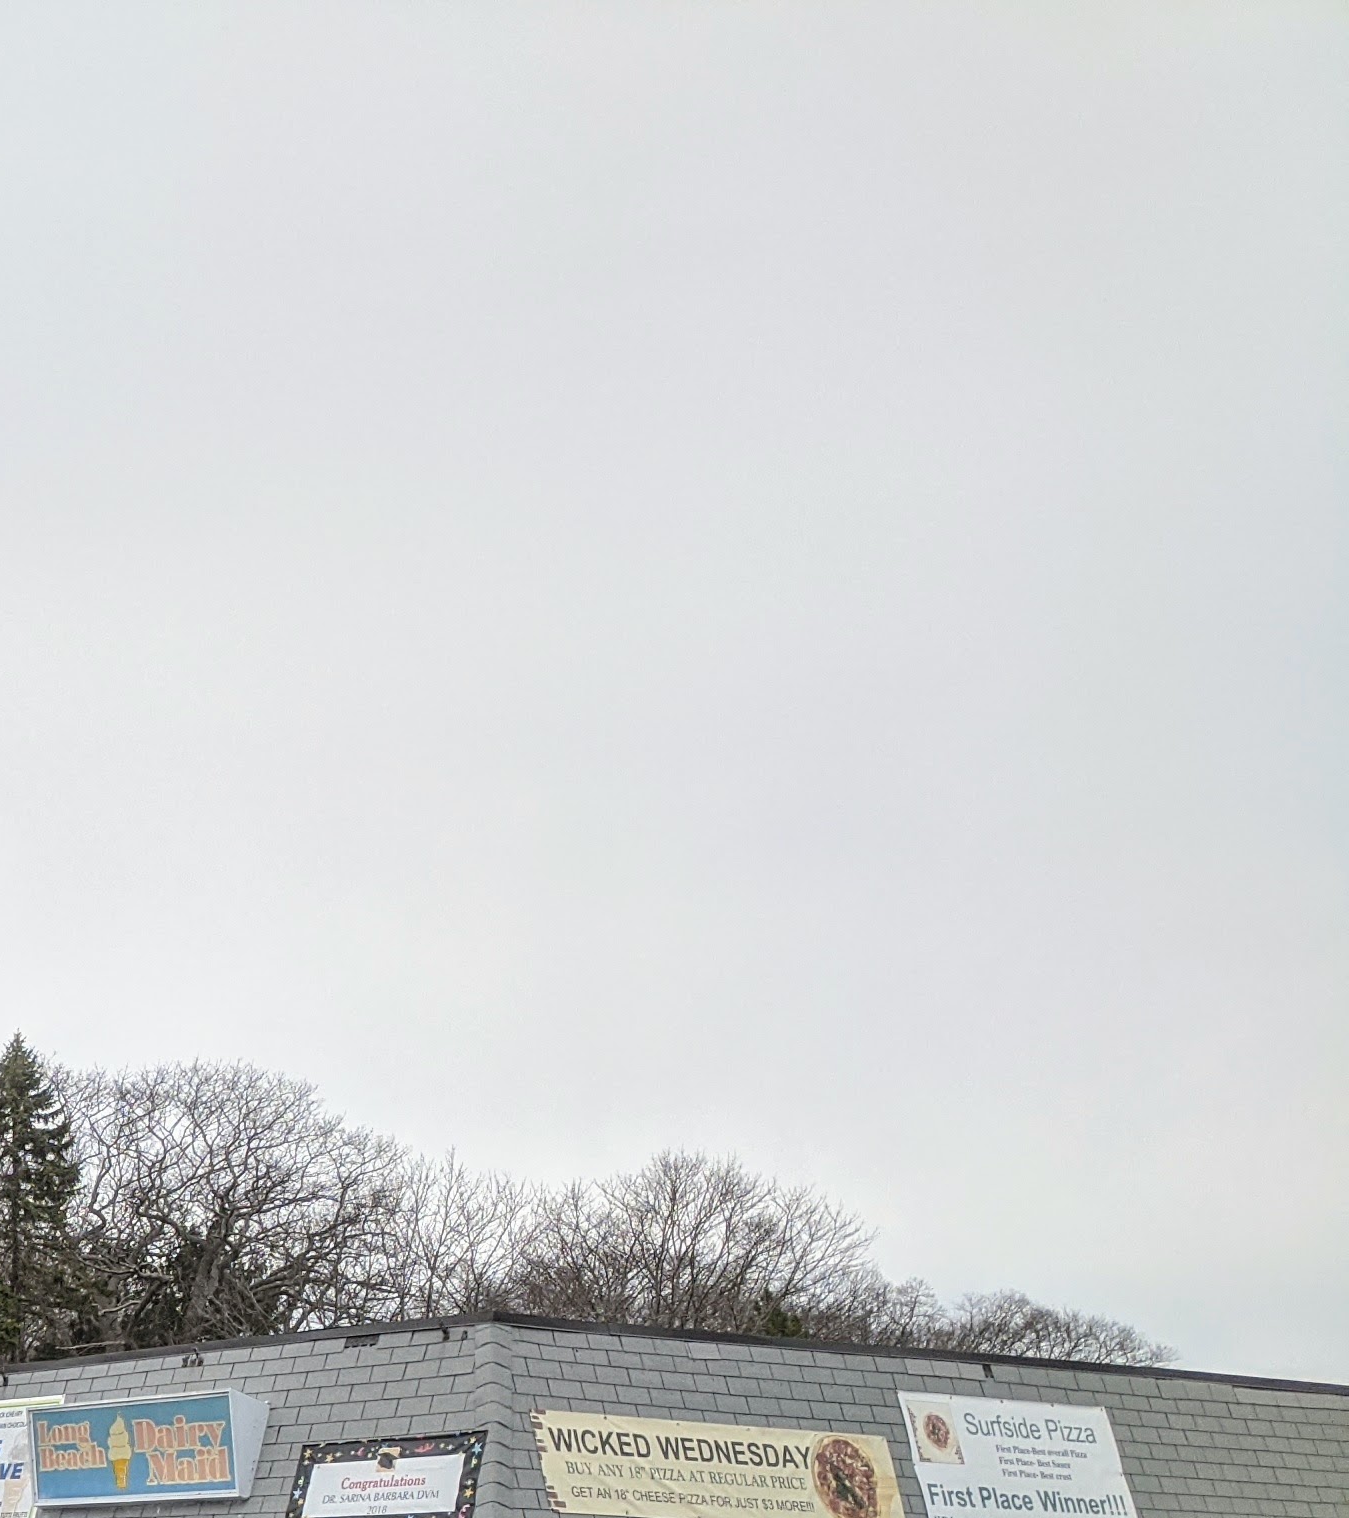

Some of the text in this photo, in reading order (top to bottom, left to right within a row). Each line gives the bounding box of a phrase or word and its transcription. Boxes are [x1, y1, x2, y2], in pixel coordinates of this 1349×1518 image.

[37, 1421, 91, 1448] Long
[132, 1415, 225, 1452] Dairy
[963, 1412, 1097, 1444] Surfside Pizza
[39, 1442, 107, 1471] Beach
[548, 1427, 810, 1470] WICKED WEDNESDAY
[146, 1446, 231, 1485] Maid
[565, 1461, 593, 1475] BUY
[598, 1464, 624, 1478] ANY
[650, 1467, 685, 1482] PIZZA
[689, 1470, 706, 1483] AT
[708, 1471, 769, 1488] REGULAR
[770, 1475, 808, 1490] PRICE
[341, 1474, 426, 1492] Congratulations
[373, 1491, 414, 1502] BARBARA
[417, 1490, 439, 1500] DVM
[367, 1505, 387, 1515] 2018
[571, 1486, 593, 1498] GET
[597, 1487, 611, 1499] AN
[632, 1489, 676, 1504] CHEESE
[678, 1493, 710, 1506] PIZZA
[710, 1495, 732, 1507] FOR
[735, 1498, 759, 1509] JUST
[761, 1499, 774, 1510] $3
[927, 1483, 1128, 1516] First Place Winner!!!
